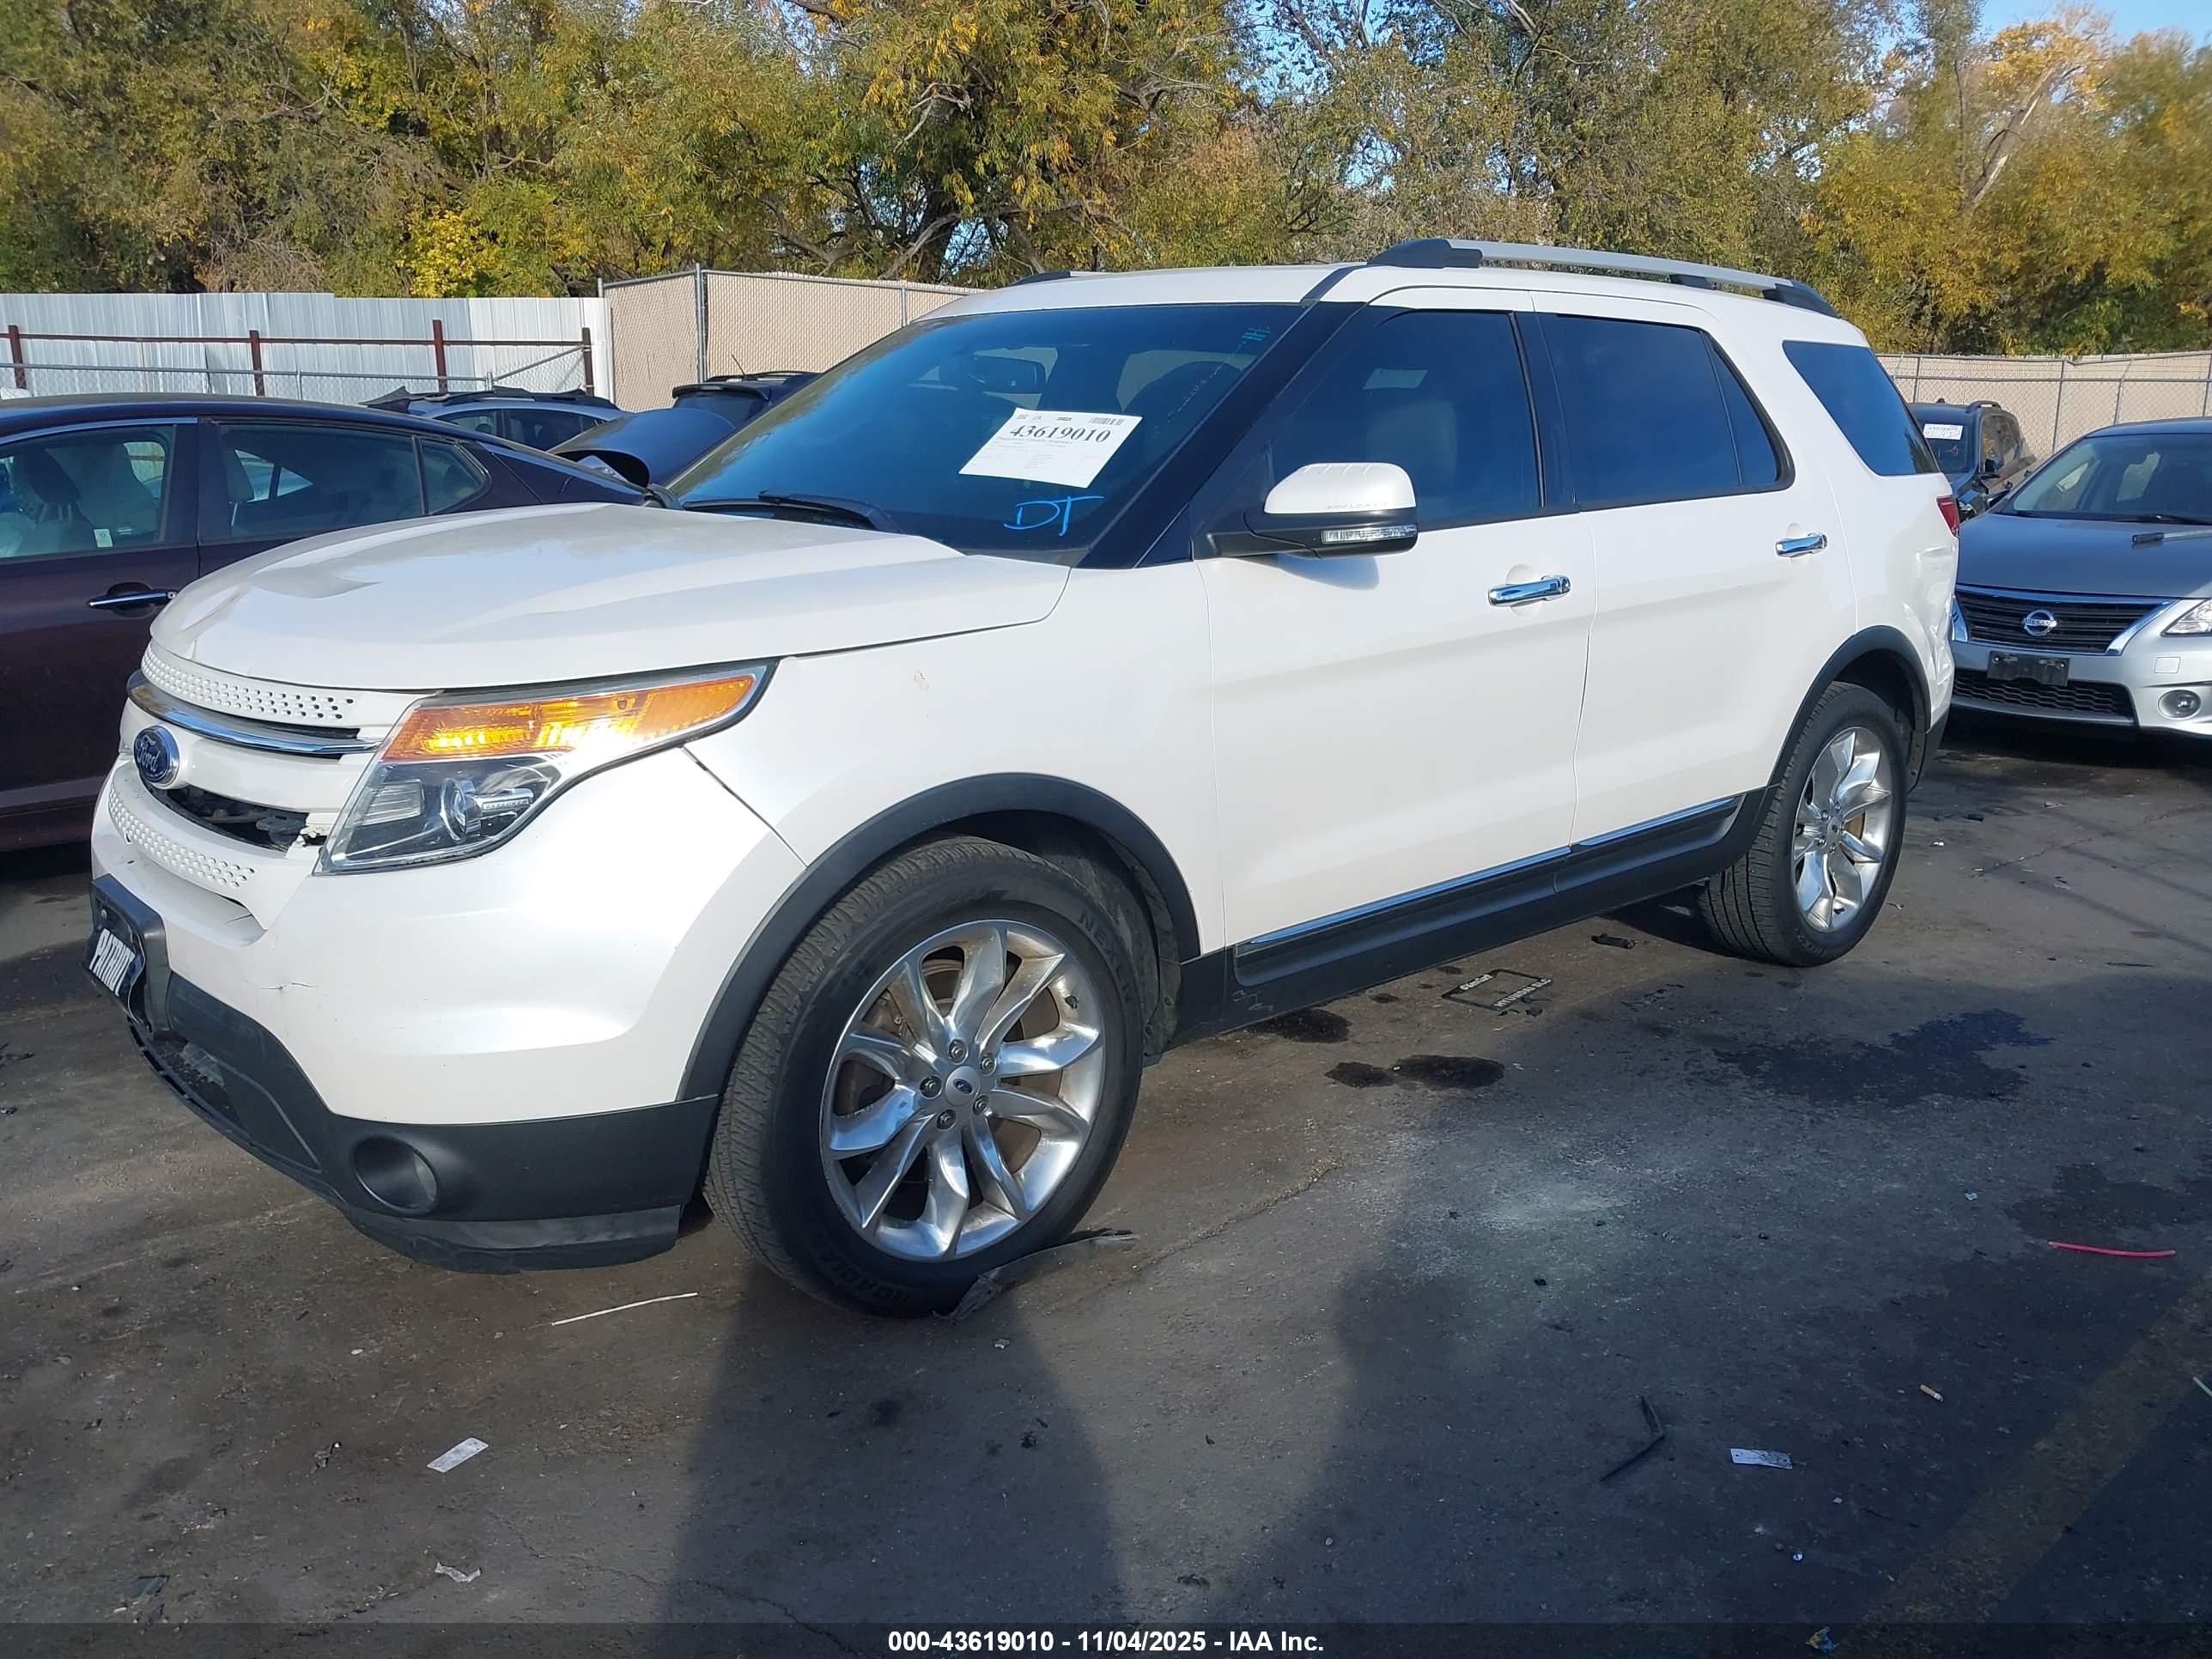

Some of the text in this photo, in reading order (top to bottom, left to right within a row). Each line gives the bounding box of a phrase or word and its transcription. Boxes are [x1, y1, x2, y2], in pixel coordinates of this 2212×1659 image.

[1010, 424, 1111, 443] 43619010
[1003, 495, 1105, 537] DT
[135, 734, 161, 773] Ford
[88, 928, 136, 997] PATRIOT
